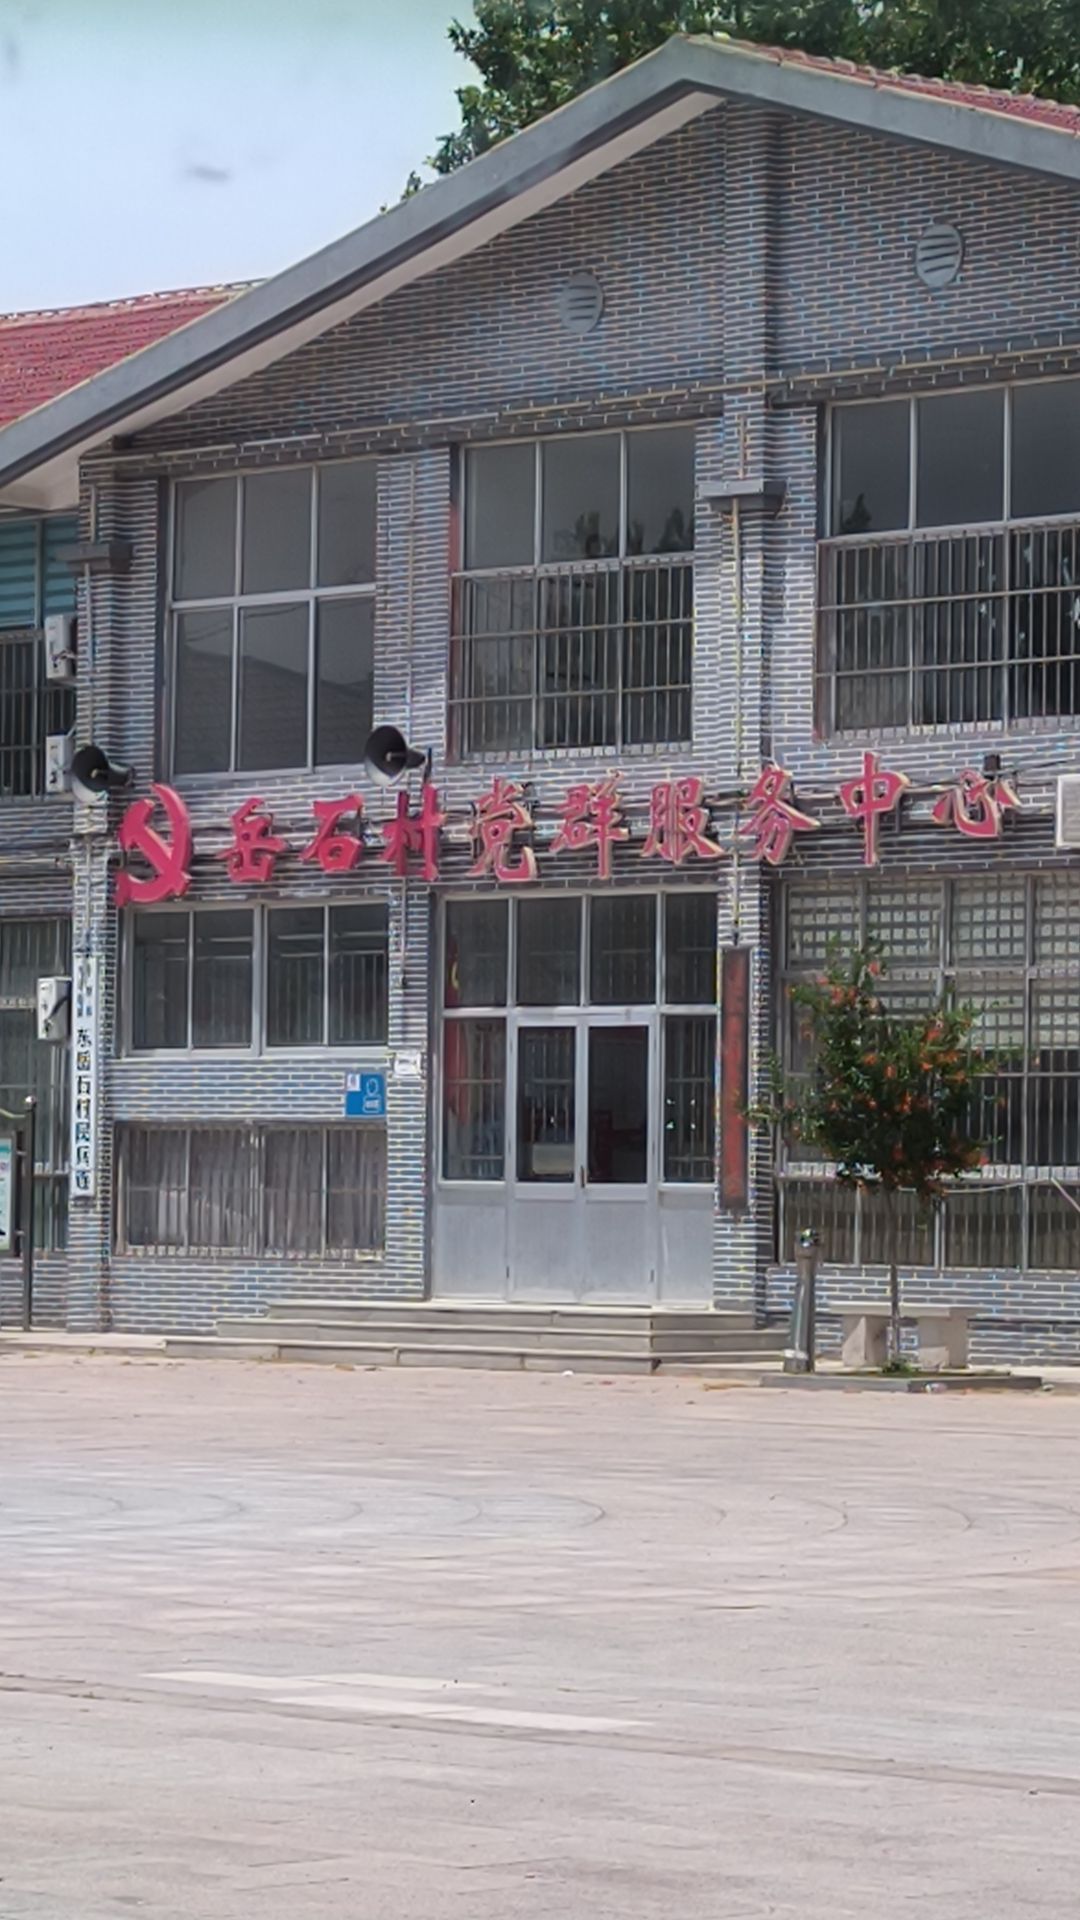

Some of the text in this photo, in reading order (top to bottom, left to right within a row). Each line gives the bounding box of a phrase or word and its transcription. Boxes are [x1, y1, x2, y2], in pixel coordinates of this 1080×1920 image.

[216, 751, 1023, 882] 岳石村党群服务中心
